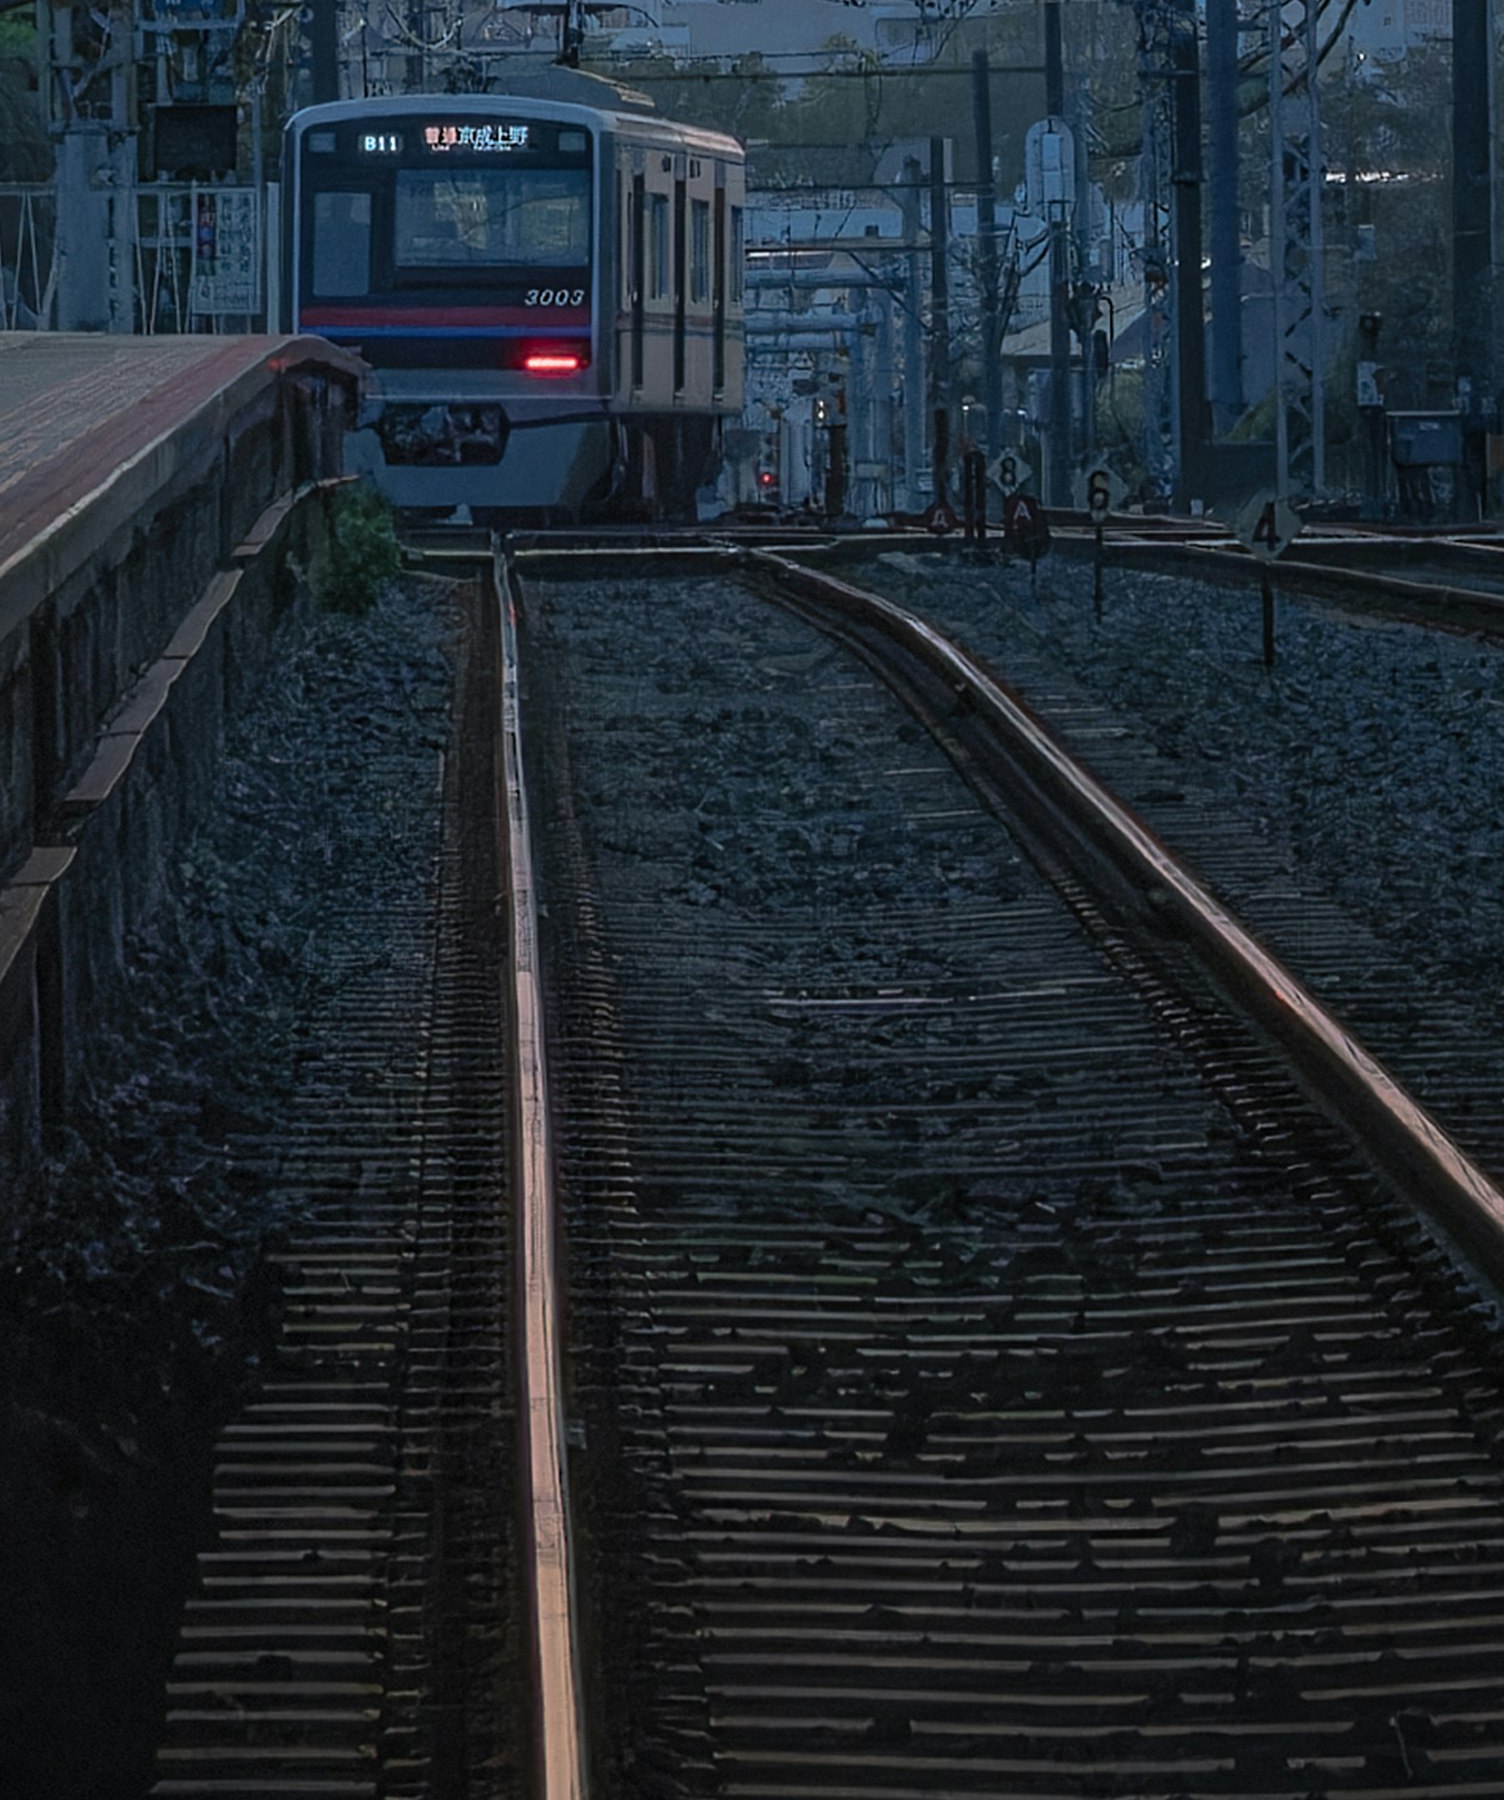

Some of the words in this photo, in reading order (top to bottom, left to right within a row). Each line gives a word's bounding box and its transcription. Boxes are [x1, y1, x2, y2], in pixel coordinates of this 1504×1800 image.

[363, 135, 398, 152] B11
[523, 287, 586, 307] 3003
[999, 456, 1017, 487] 8
[1012, 499, 1033, 521] A
